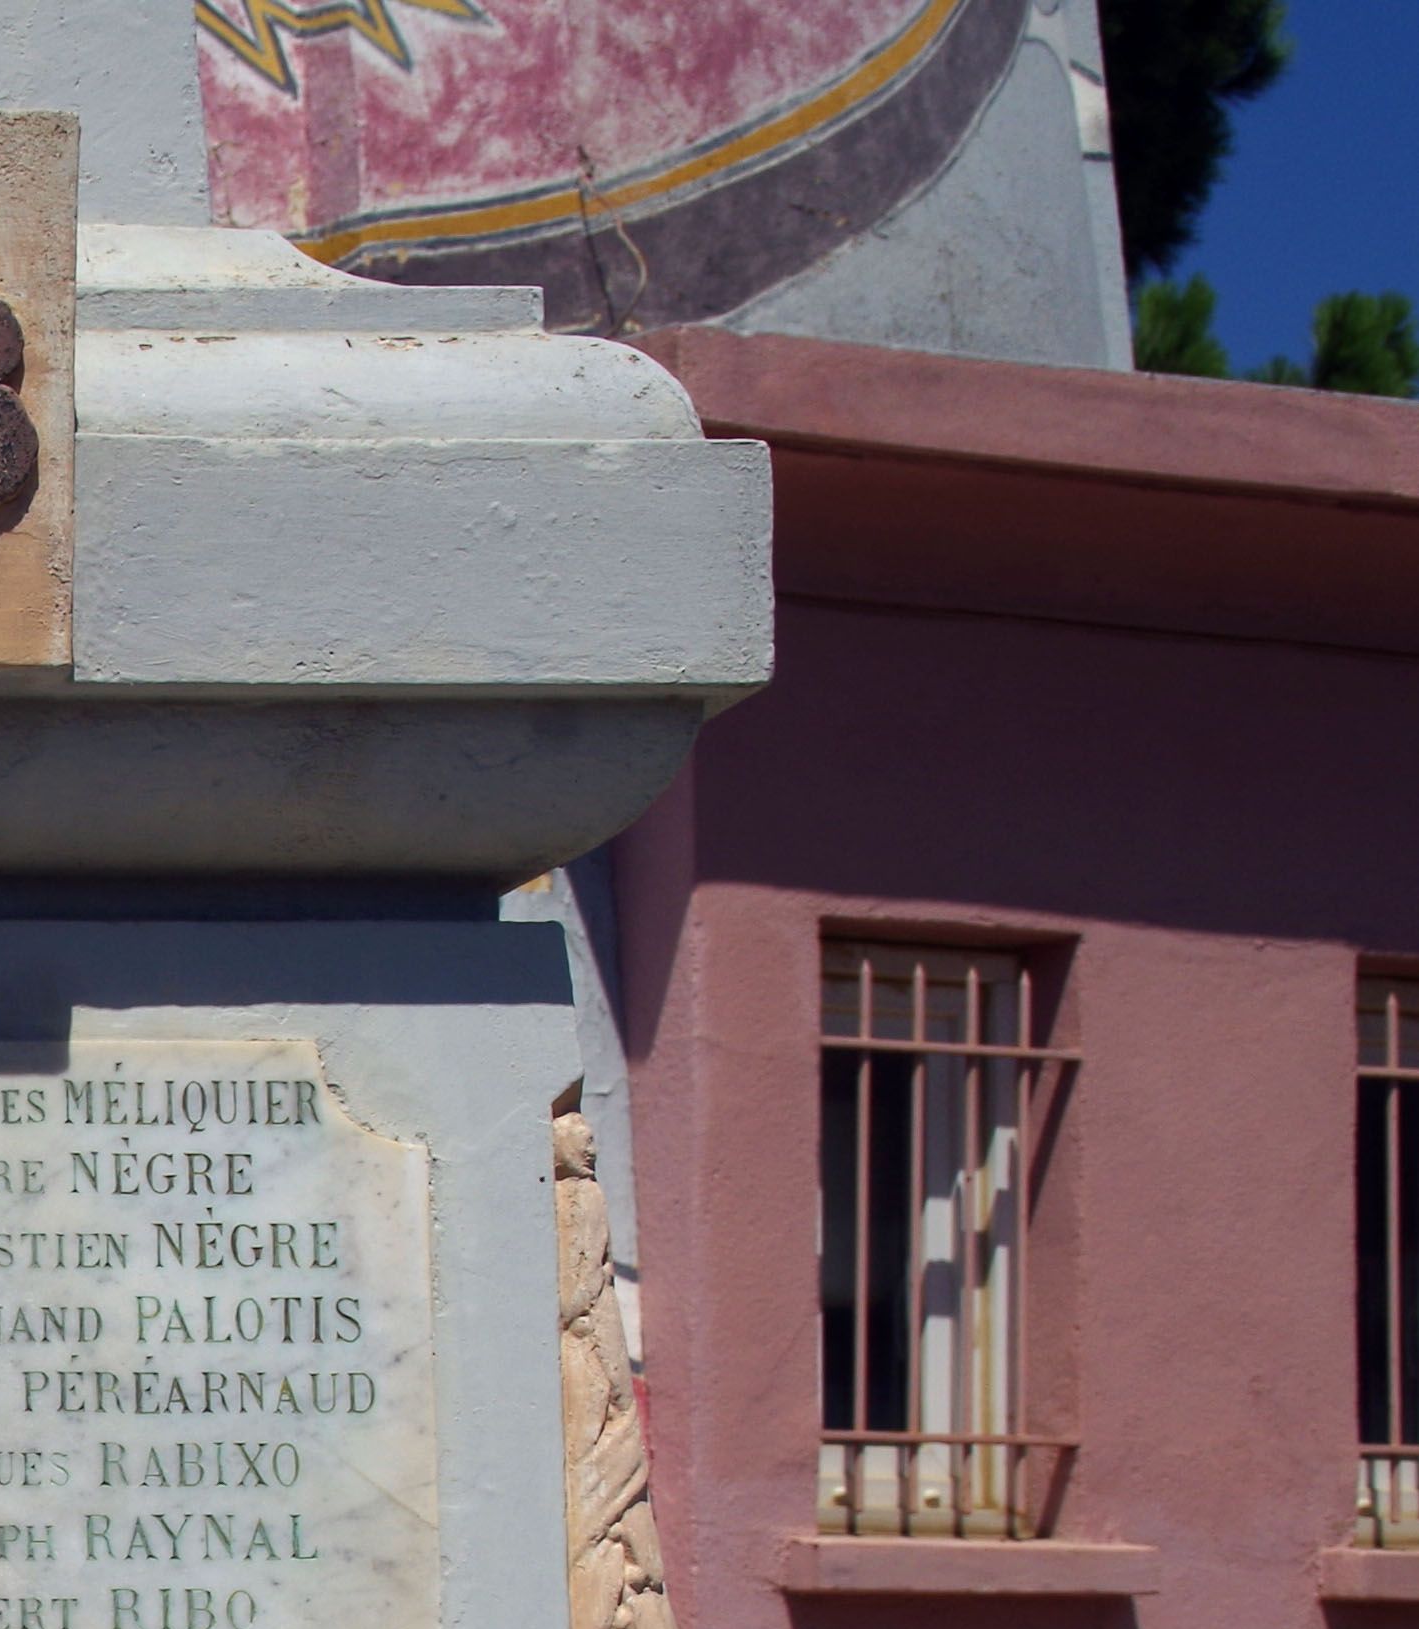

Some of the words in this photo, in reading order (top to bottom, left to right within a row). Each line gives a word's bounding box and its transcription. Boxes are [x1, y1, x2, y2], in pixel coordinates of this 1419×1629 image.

[63, 1061, 321, 1133] MÉLIQUIER
[70, 1138, 255, 1196] NÈGRE
[152, 1208, 340, 1270] NÈGRE
[136, 1296, 363, 1343] PALOTIS
[22, 1356, 377, 1415] PÉRÉARNAUD
[98, 1441, 301, 1488] RABIXO
[84, 1514, 319, 1561] RAYNAL
